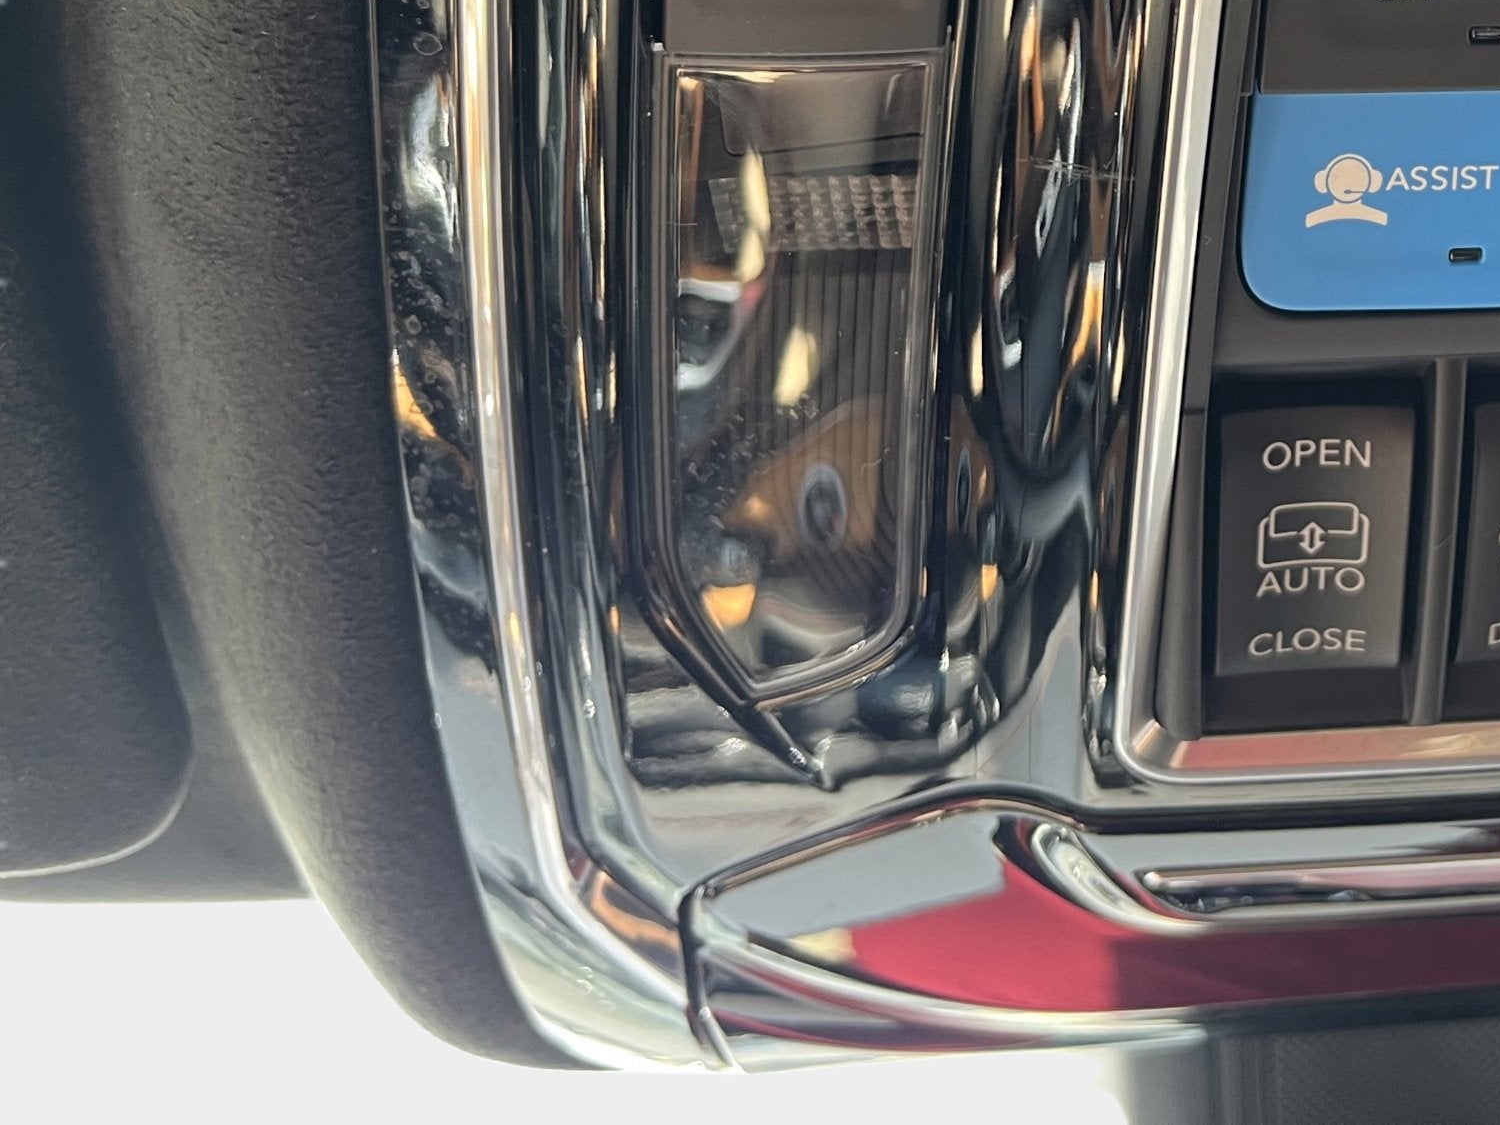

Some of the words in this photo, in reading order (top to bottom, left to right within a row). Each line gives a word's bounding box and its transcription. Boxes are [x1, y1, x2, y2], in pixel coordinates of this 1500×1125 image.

[1386, 166, 1499, 192] ASSIST
[1262, 439, 1372, 470] OPEN
[1255, 567, 1366, 597] AUTO
[1248, 628, 1366, 657] CLOSE
